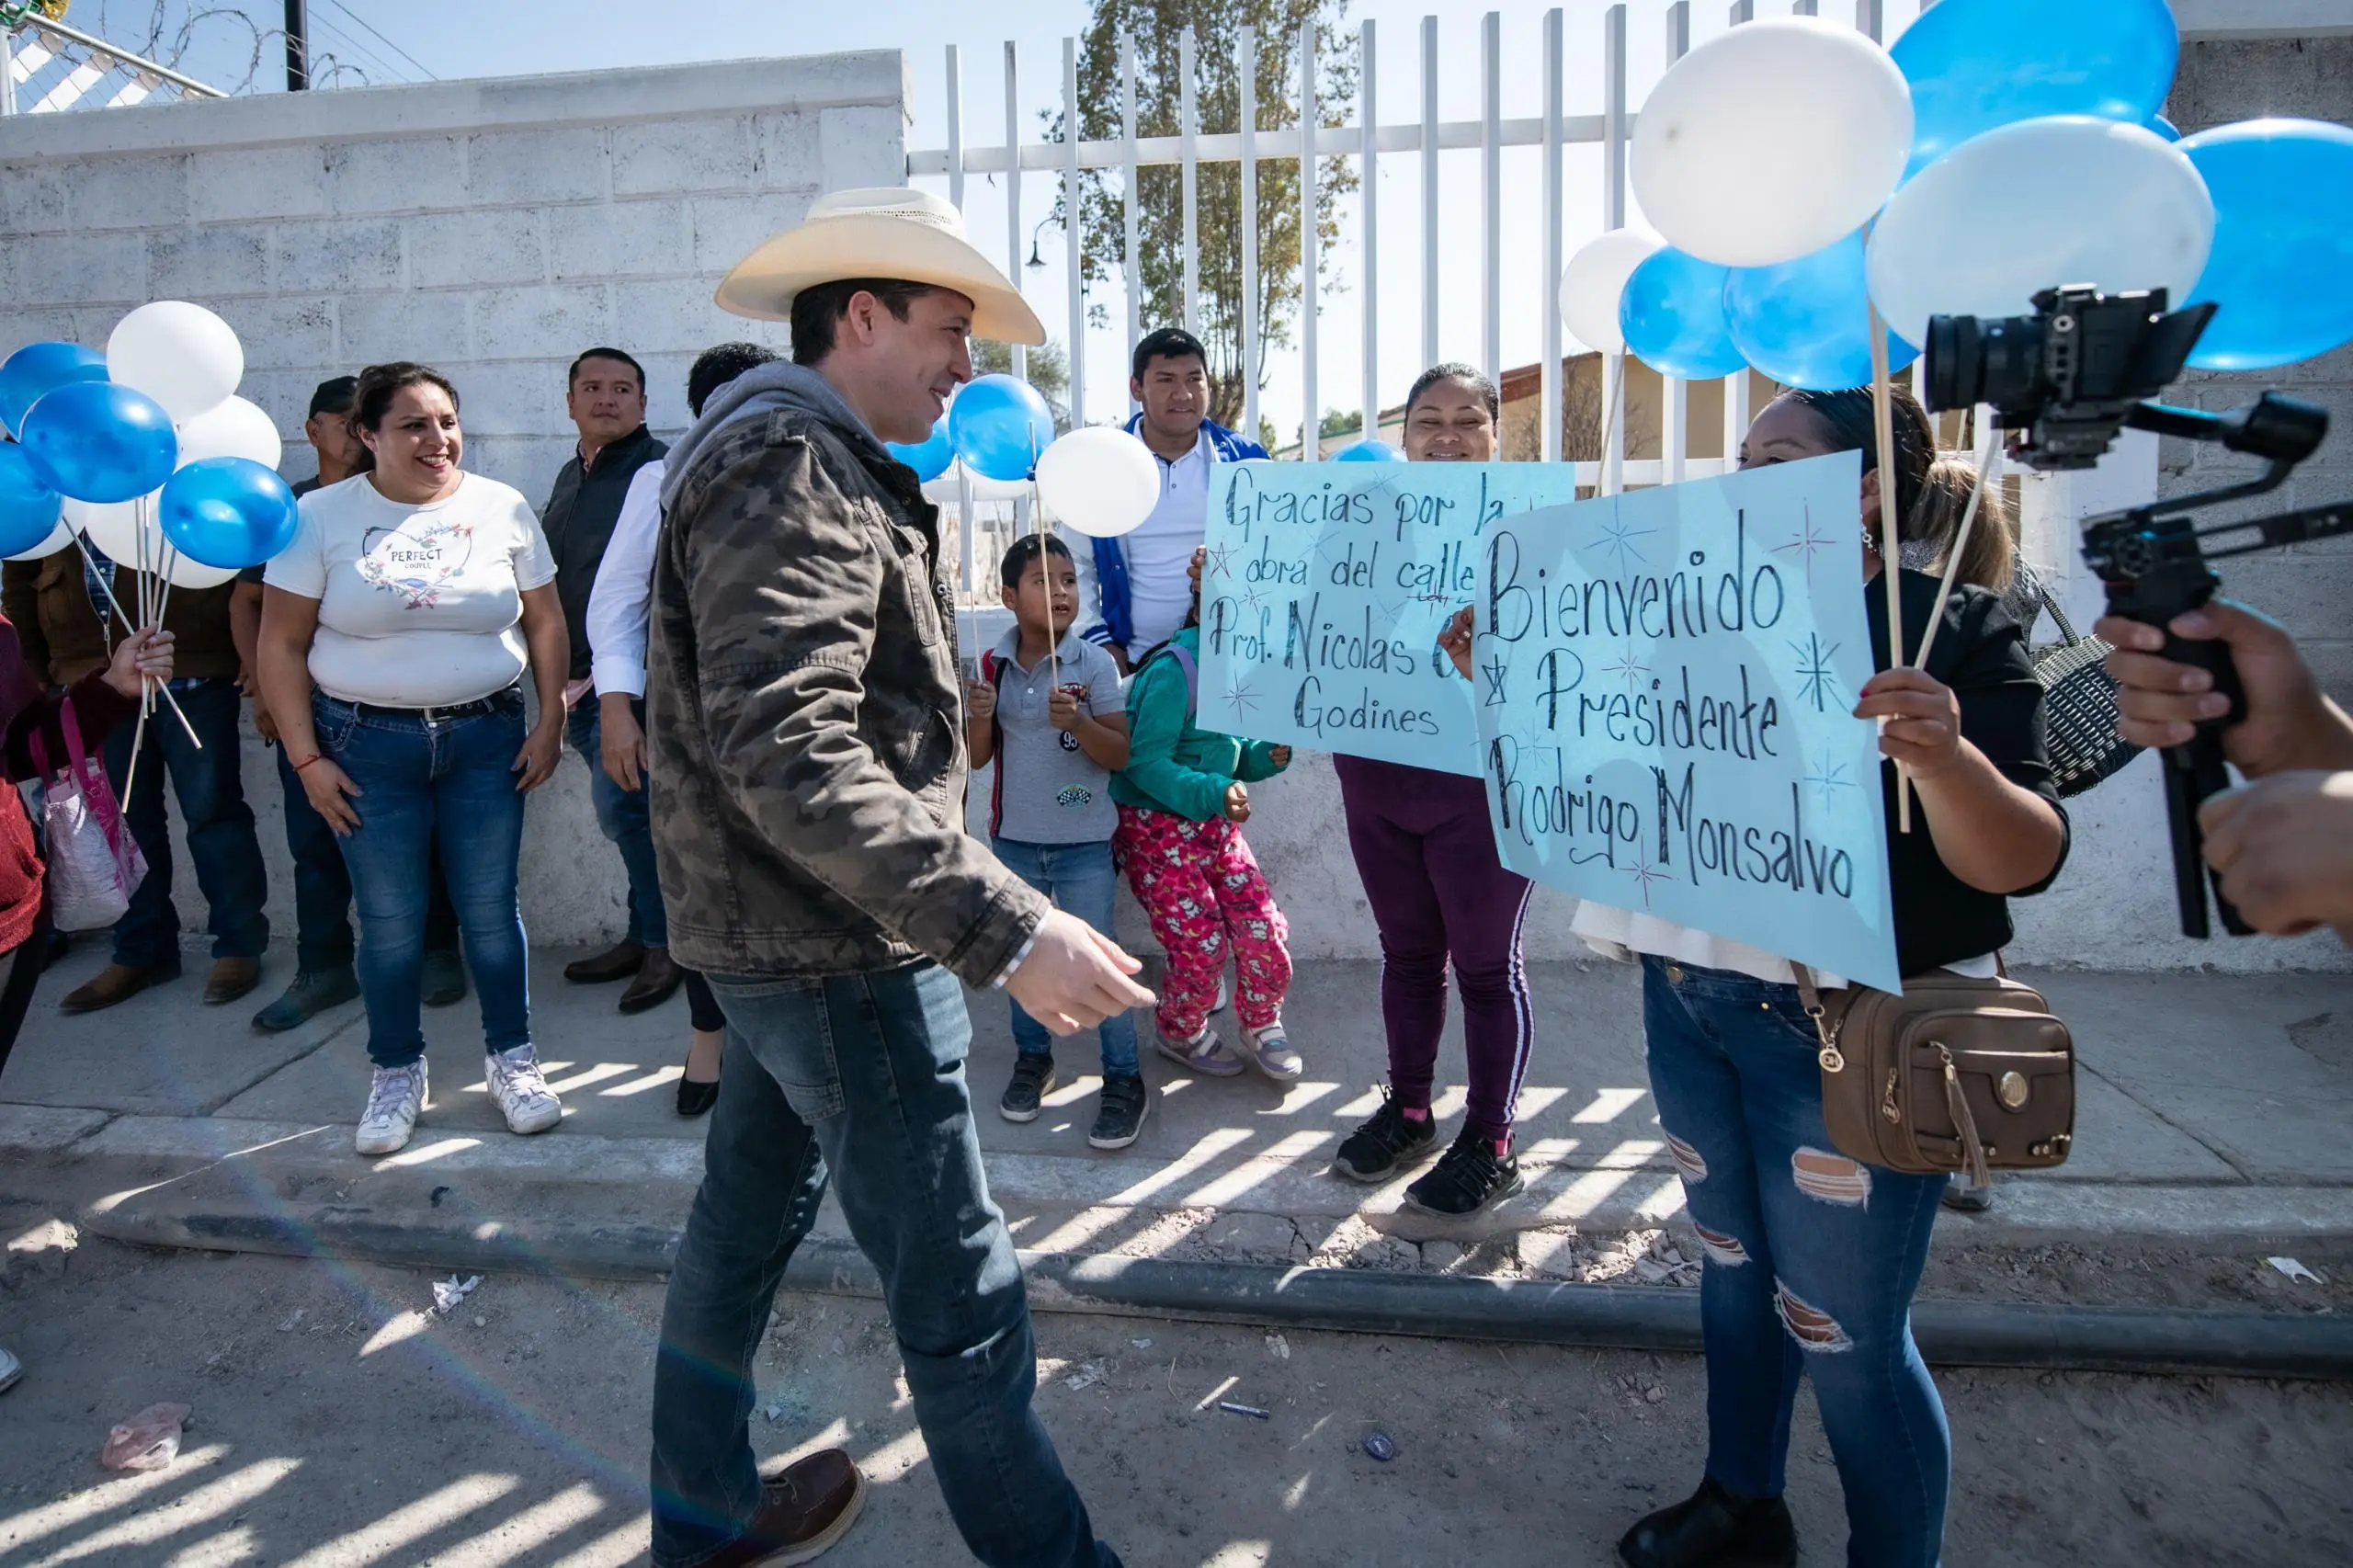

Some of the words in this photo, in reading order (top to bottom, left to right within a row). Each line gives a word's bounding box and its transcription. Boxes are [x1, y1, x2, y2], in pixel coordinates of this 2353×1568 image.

[1225, 467, 1374, 542] Gracias
[1395, 493, 1456, 542] por
[1473, 472, 1504, 536] la
[391, 548, 443, 562] PERFECT
[1245, 535, 1308, 585] obra
[1330, 541, 1379, 589] del
[1396, 540, 1474, 596] calle
[1477, 508, 1785, 643] Bienvenido
[1209, 596, 1273, 664] Prof.
[1284, 592, 1415, 676] Nicolas
[1063, 731, 1078, 748] 95
[1294, 676, 1440, 739] Godines
[1536, 648, 1779, 761] Presidente
[1488, 733, 1640, 869] Rodrigo
[1648, 761, 1854, 900] Monsalvo
